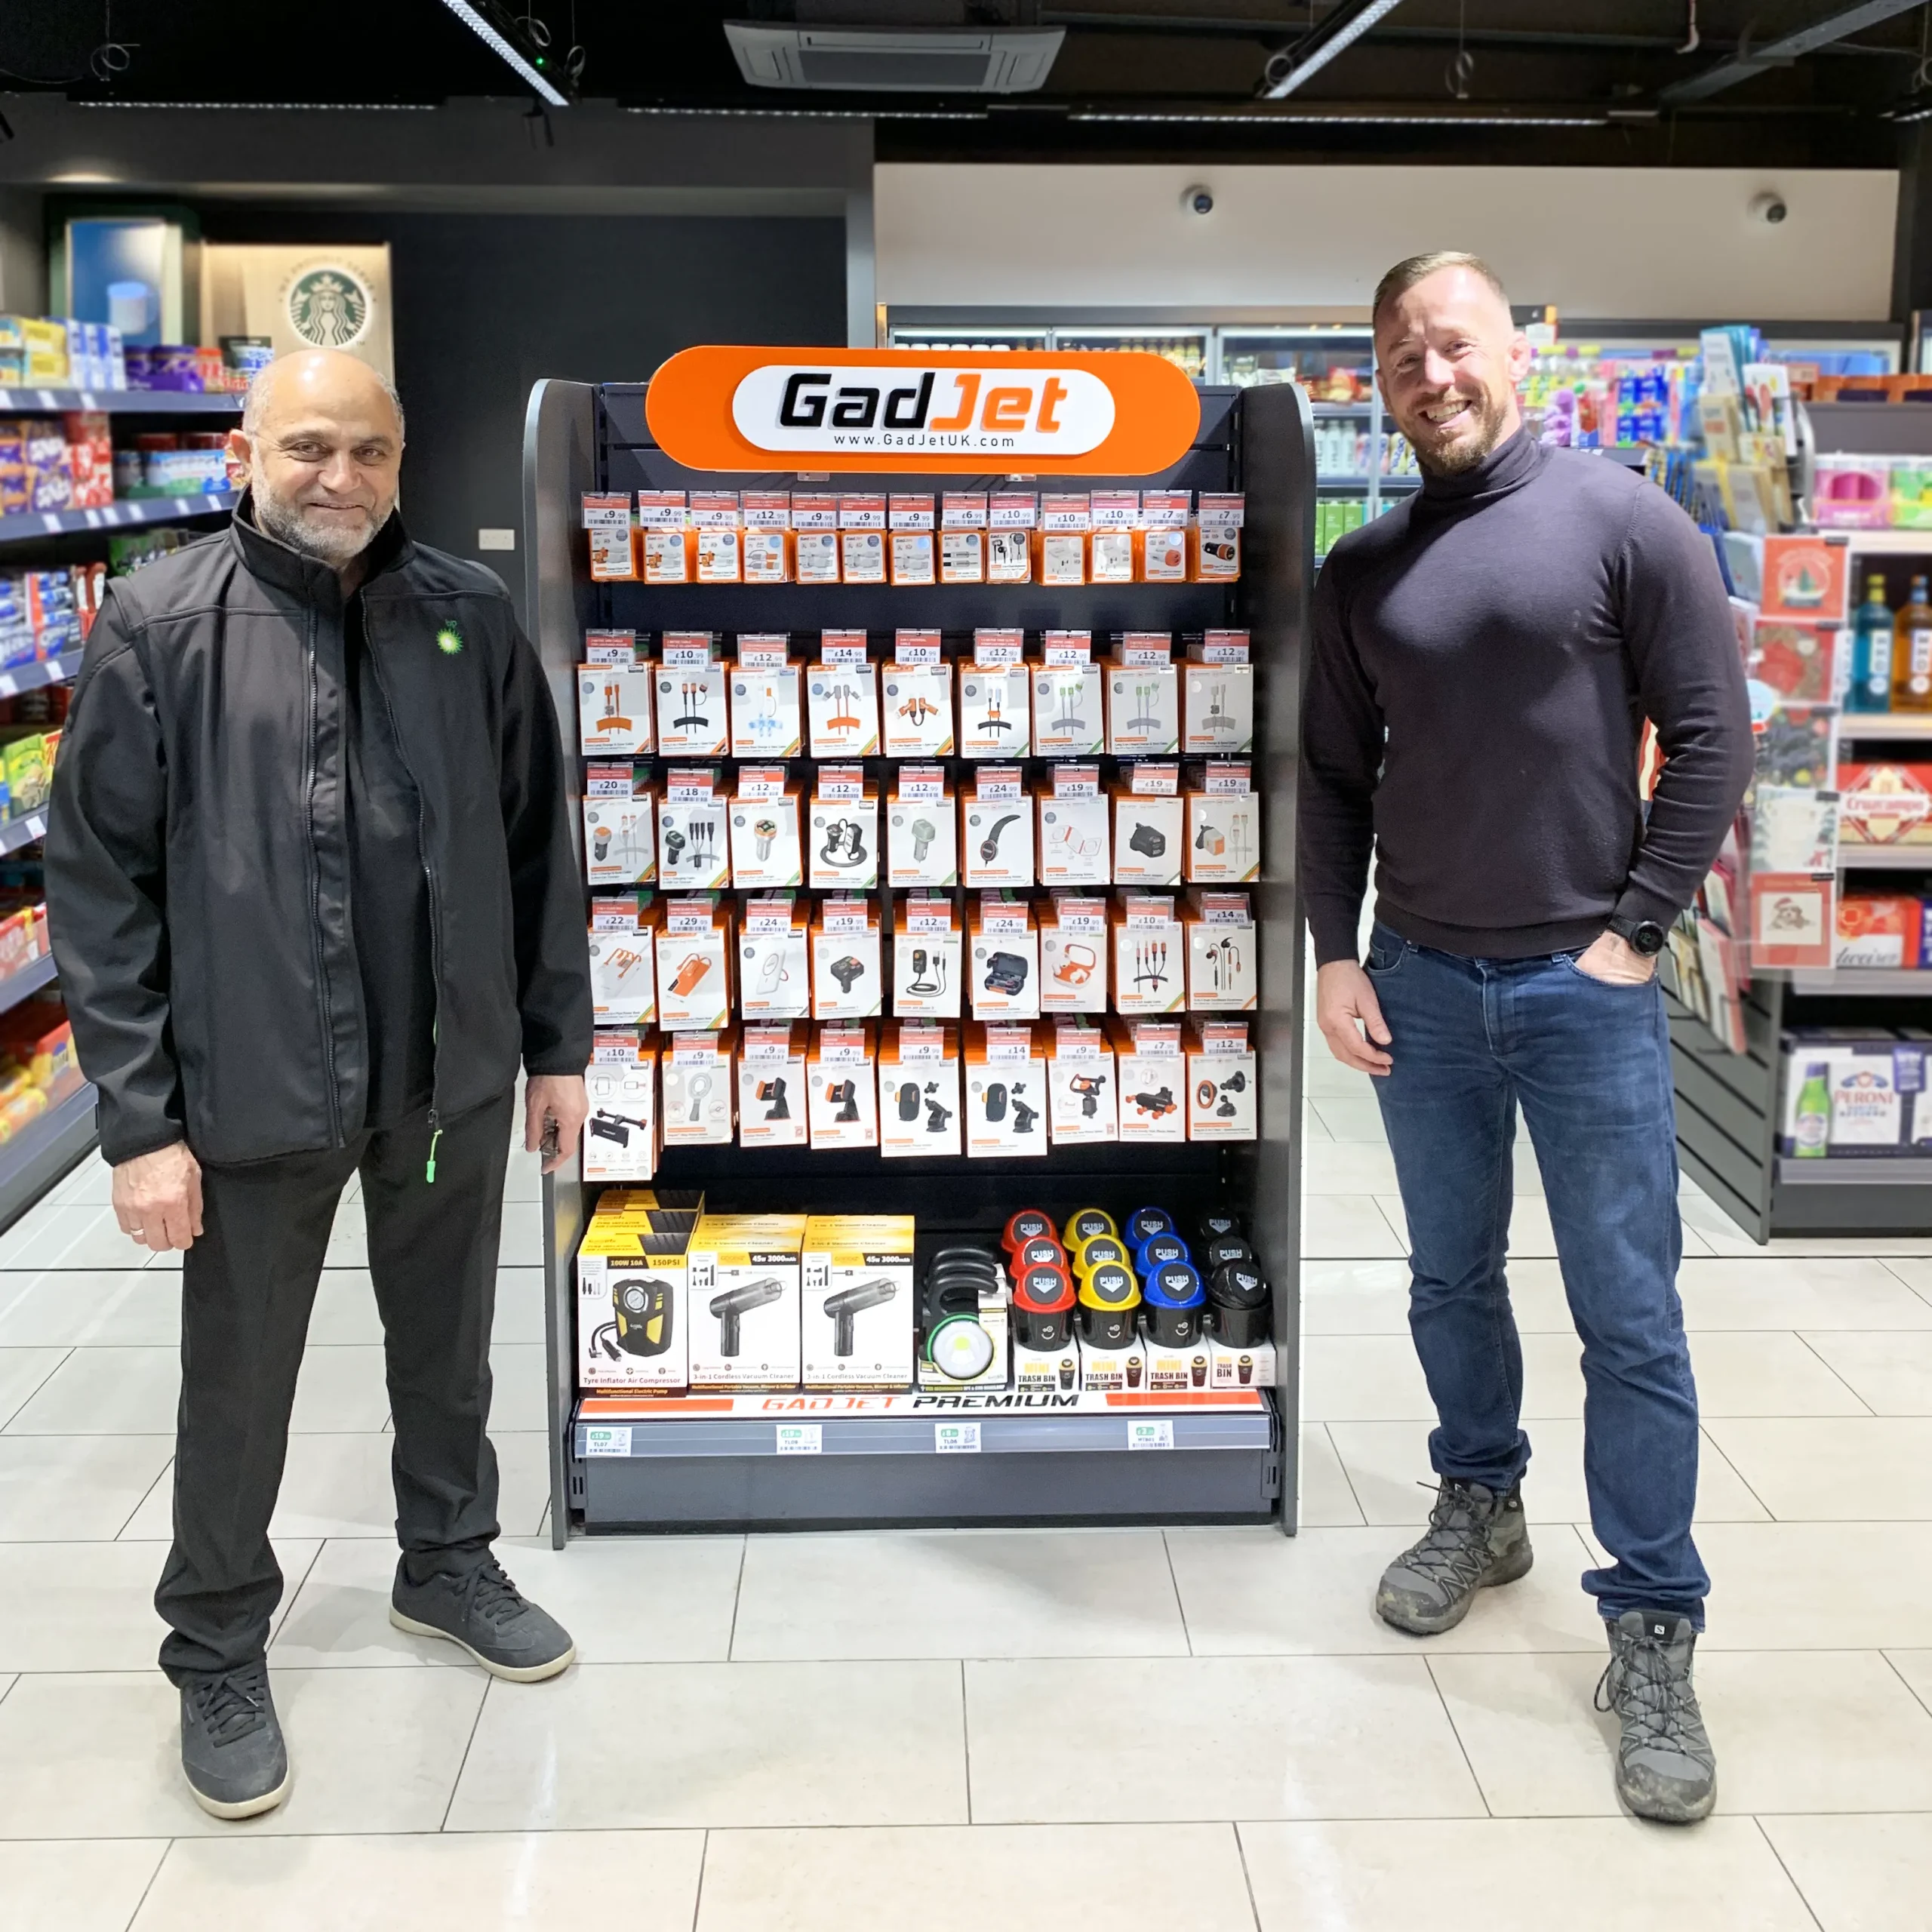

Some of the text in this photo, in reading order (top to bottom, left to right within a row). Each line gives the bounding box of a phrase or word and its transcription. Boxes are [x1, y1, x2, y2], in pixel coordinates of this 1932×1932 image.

[779, 372, 1068, 432] GadJet
[834, 432, 1016, 448] www.GadJetUK.com
[1141, 1220, 1164, 1229] PUSH
[1209, 1219, 1231, 1227] PUSH
[1155, 1248, 1178, 1257] PUSH
[1100, 1276, 1123, 1284] PUSH
[1165, 1275, 1189, 1284] PUSH
[1236, 1272, 1258, 1285] PUSH
[1217, 1368, 1232, 1377] BIN
[761, 1394, 1080, 1411] GADJET PREMIUM
